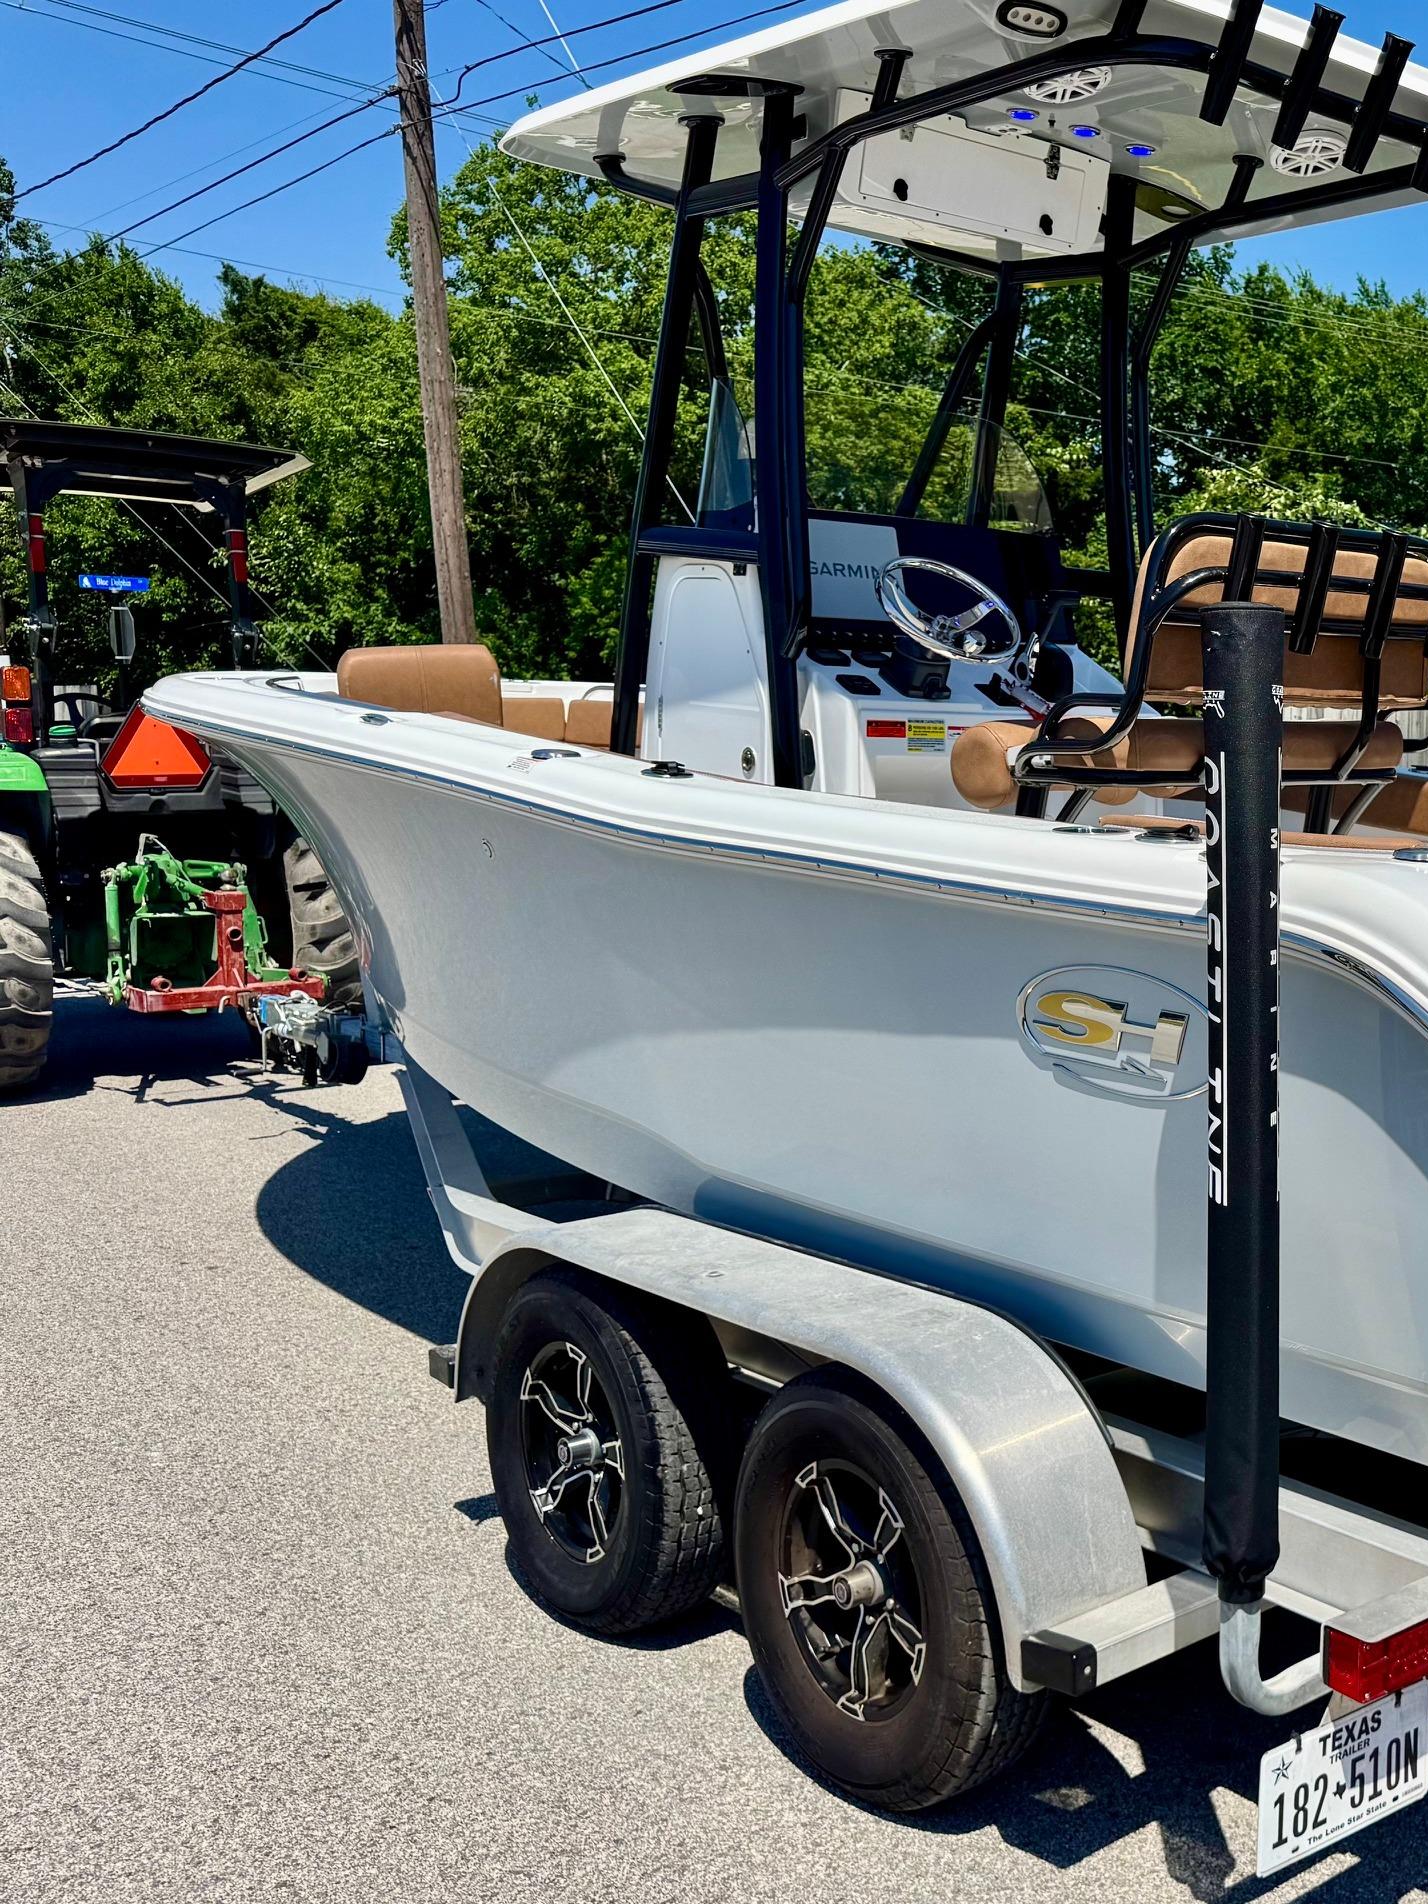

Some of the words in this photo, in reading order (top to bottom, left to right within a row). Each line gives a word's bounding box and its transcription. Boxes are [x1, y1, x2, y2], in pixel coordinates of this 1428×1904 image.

[1318, 1709, 1382, 1757] TEXAS
[1330, 1738, 1370, 1764] TRAILER
[1272, 1773, 1329, 1850] 182
[1307, 1832, 1323, 1846] The
[1325, 1822, 1345, 1837] Lone
[1347, 1813, 1364, 1826] Star
[1366, 1800, 1387, 1816] State
